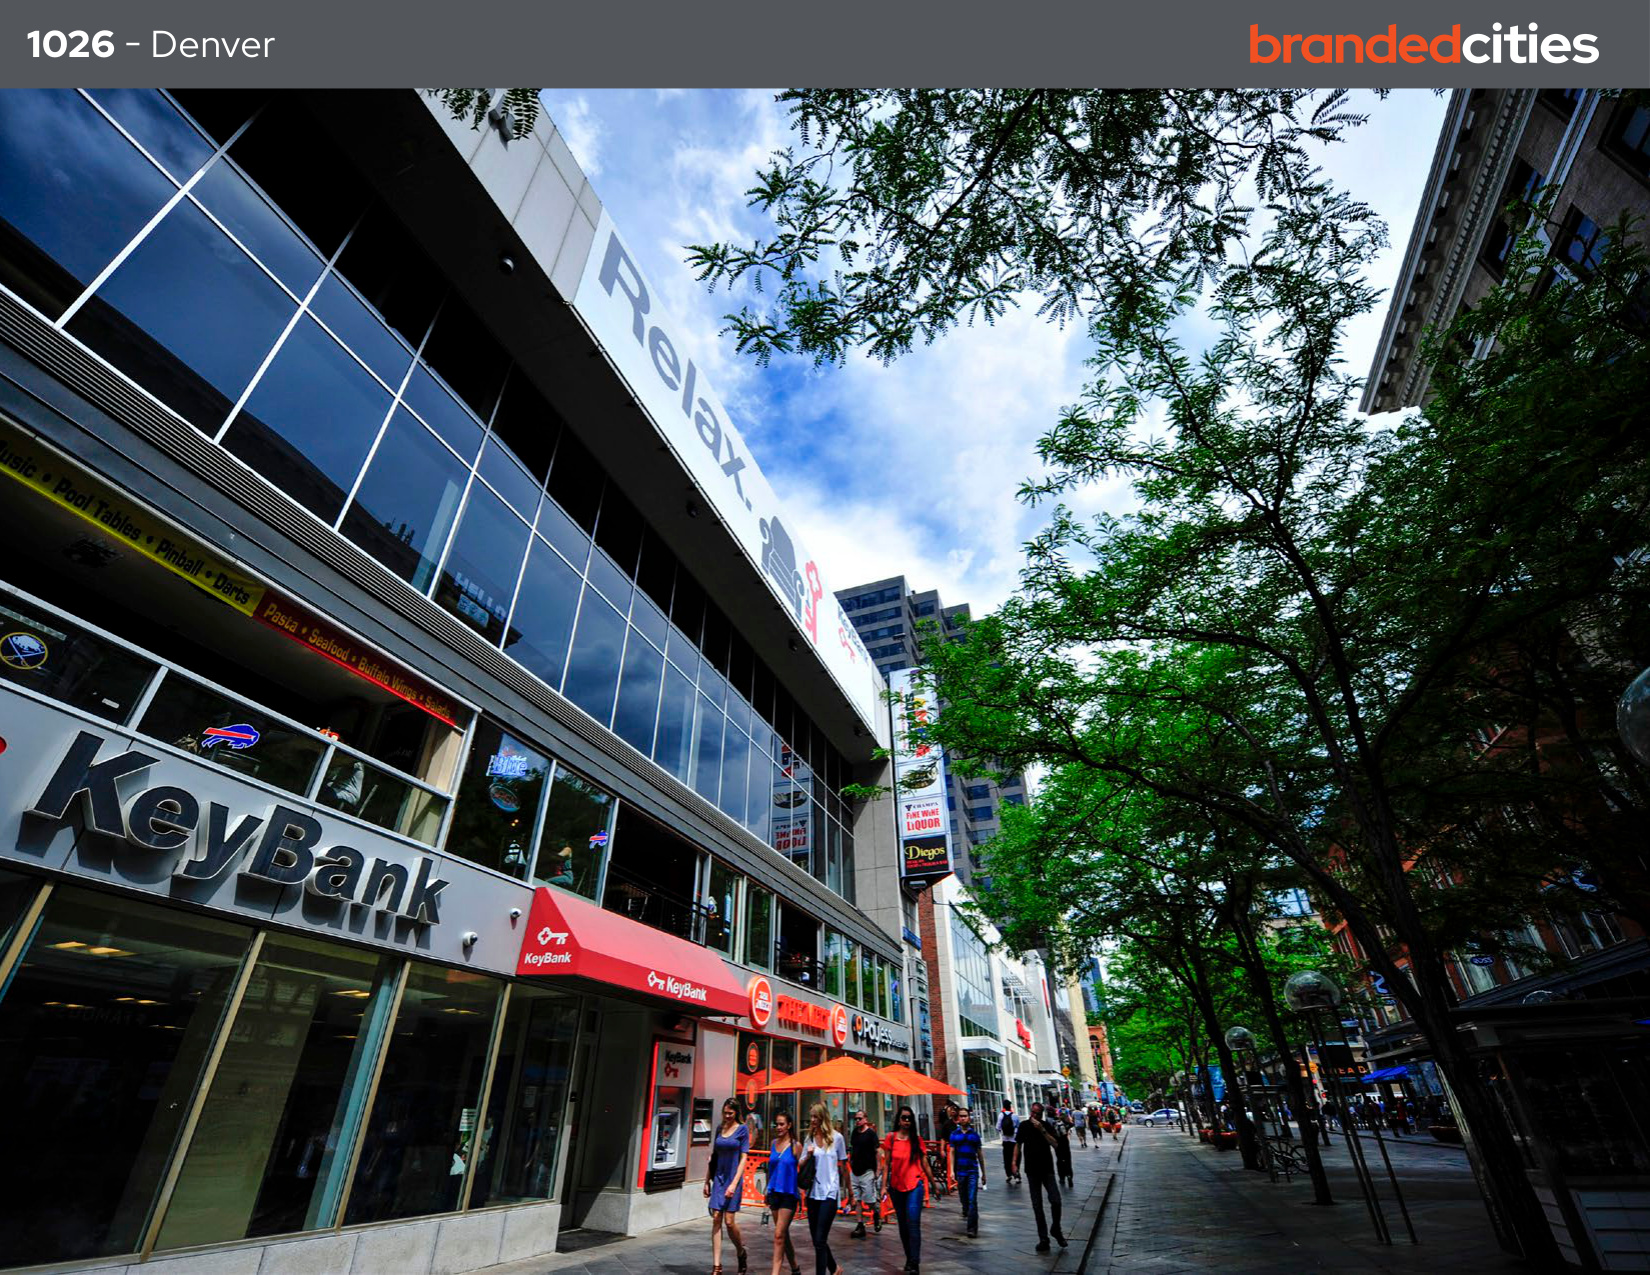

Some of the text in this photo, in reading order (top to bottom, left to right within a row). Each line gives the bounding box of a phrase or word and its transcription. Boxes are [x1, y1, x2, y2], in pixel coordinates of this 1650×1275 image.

[598, 230, 752, 512] Relax.
[52, 477, 94, 511] Pool
[92, 501, 142, 541] Tables
[154, 538, 206, 578] Pinball
[211, 573, 251, 605] Darts
[263, 603, 451, 719] Pasta Seafood Buffalo Wings Salads
[24, 730, 450, 925] KeyBank
[905, 845, 946, 861] Diegos
[524, 952, 572, 968] KeyBank
[666, 976, 707, 1002] KeyBank
[665, 1049, 692, 1065] KeyBank
